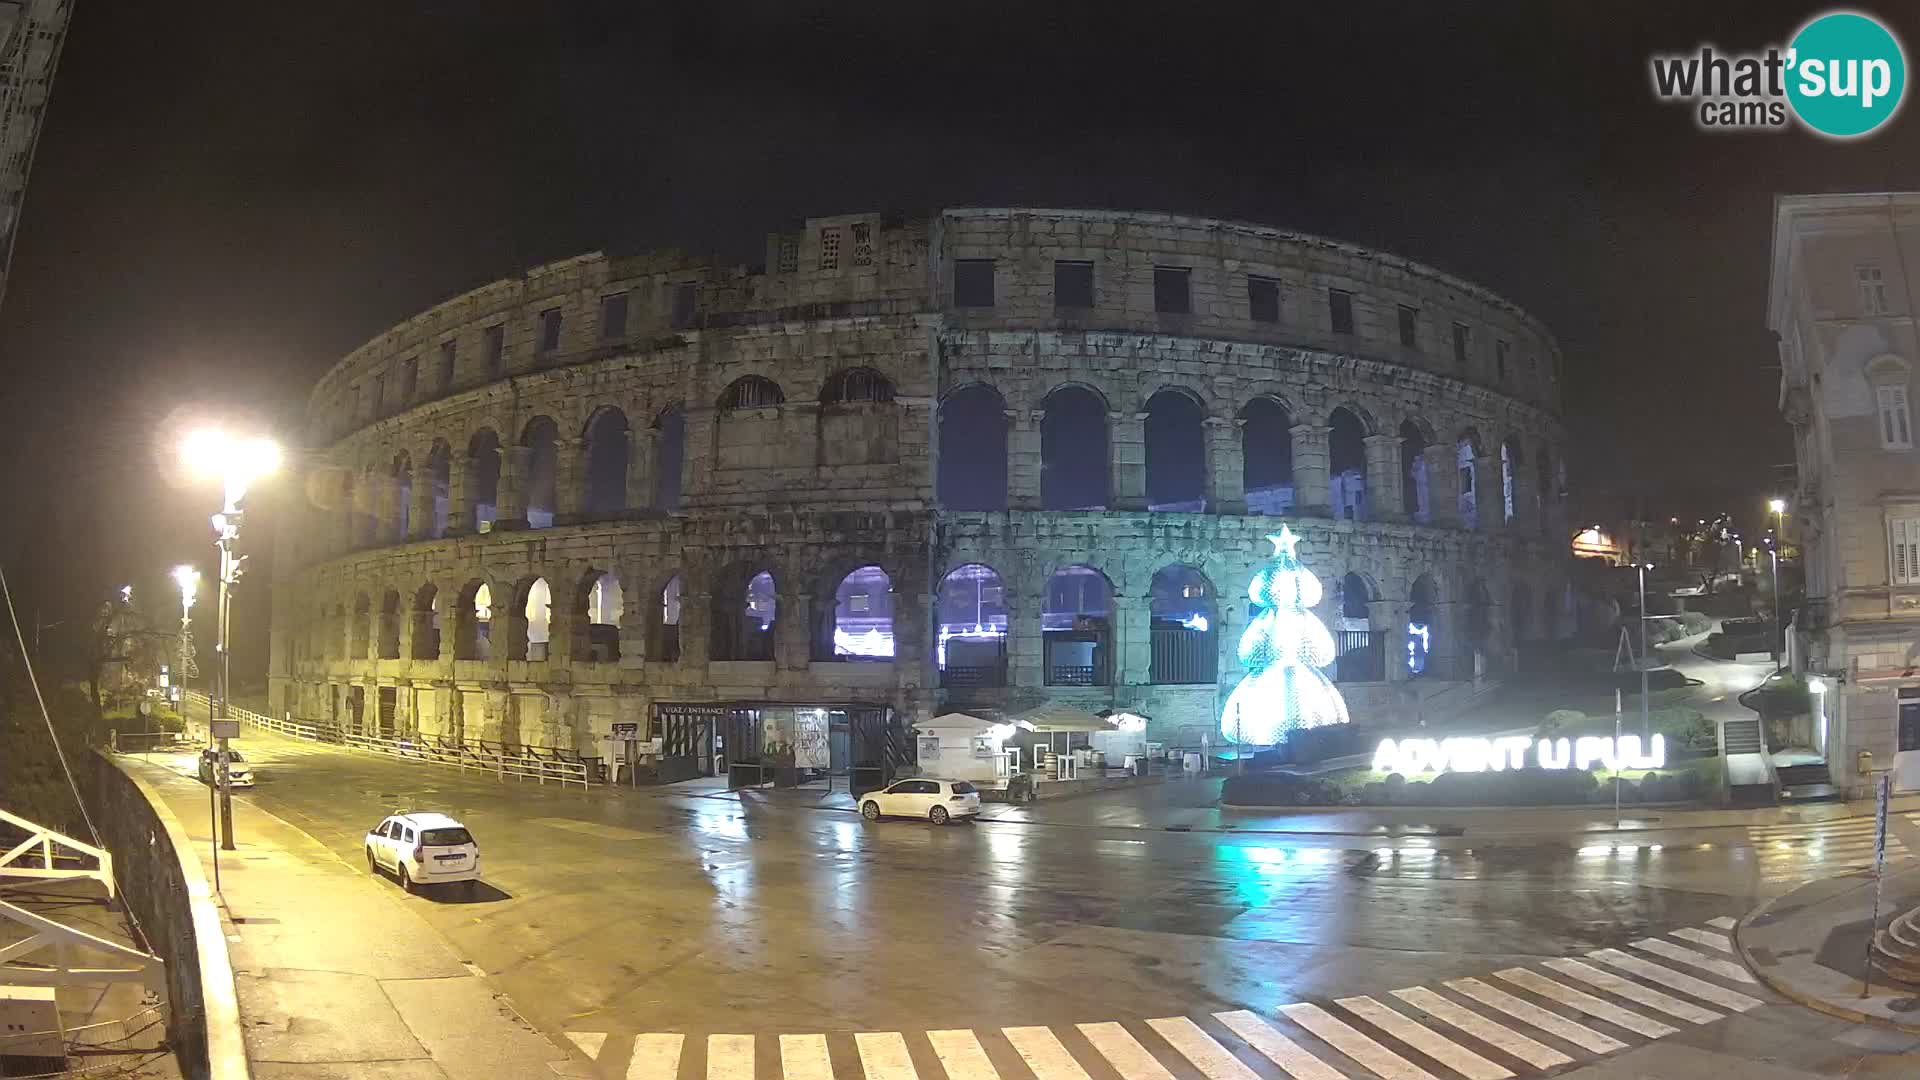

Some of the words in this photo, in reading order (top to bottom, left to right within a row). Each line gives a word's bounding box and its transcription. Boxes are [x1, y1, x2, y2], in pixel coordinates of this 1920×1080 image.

[688, 706, 724, 715] ENTRANCE
[1373, 737, 1533, 772] ADVENT
[1538, 738, 1570, 770] U
[1574, 733, 1665, 770] PULI
